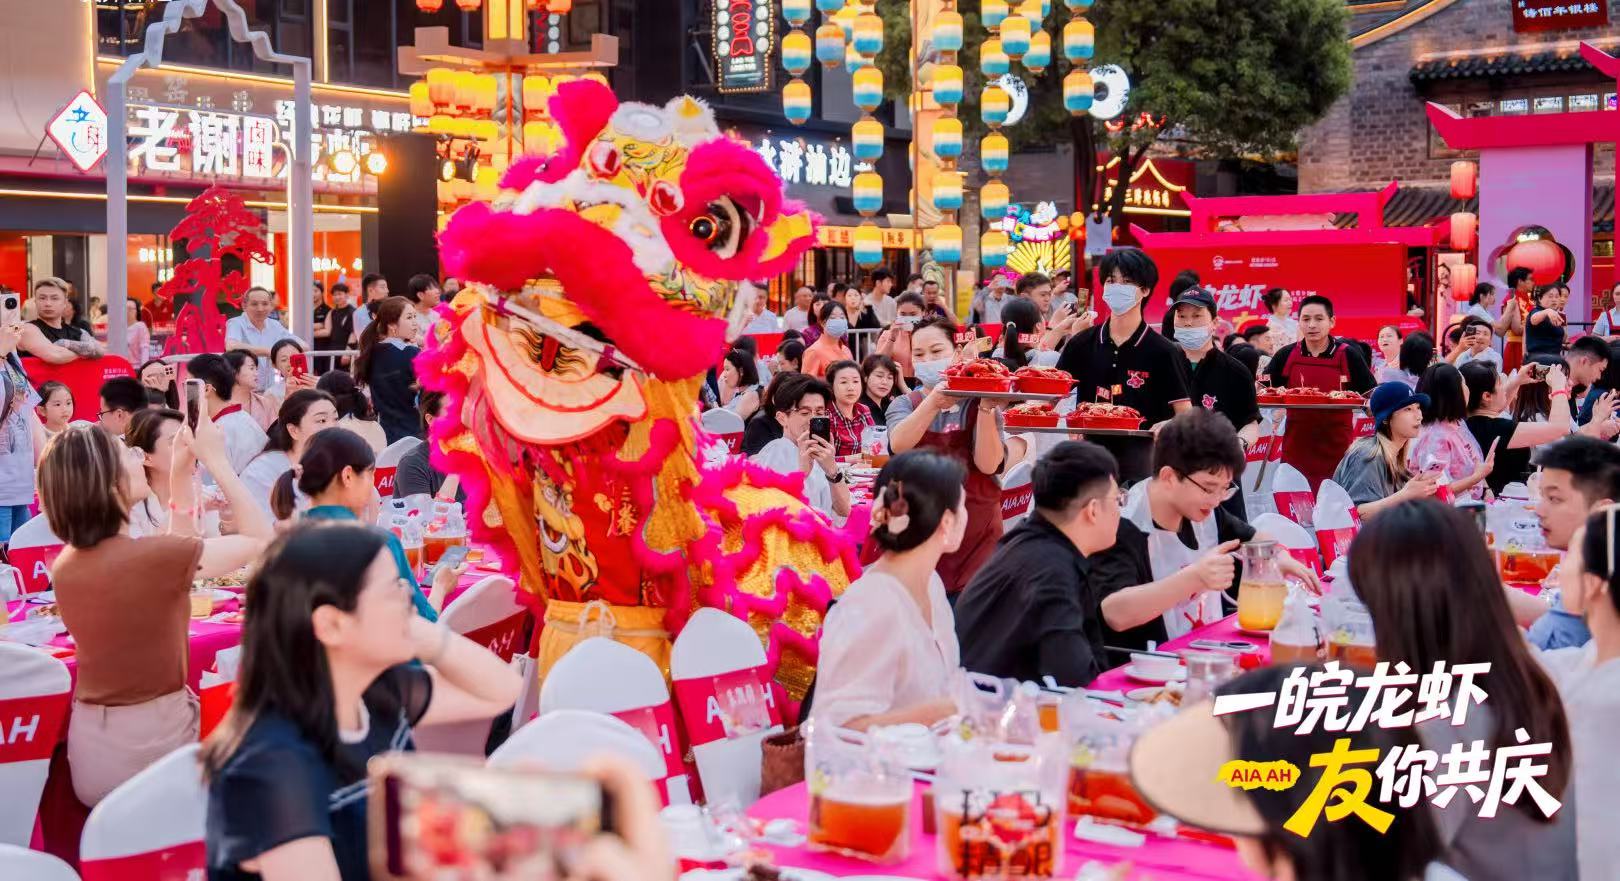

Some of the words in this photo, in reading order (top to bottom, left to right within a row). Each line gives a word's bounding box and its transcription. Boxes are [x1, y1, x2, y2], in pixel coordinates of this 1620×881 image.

[127, 106, 238, 174] 老谢
[727, 438, 737, 449] H
[377, 475, 395, 490] AI
[0, 714, 40, 745] H
